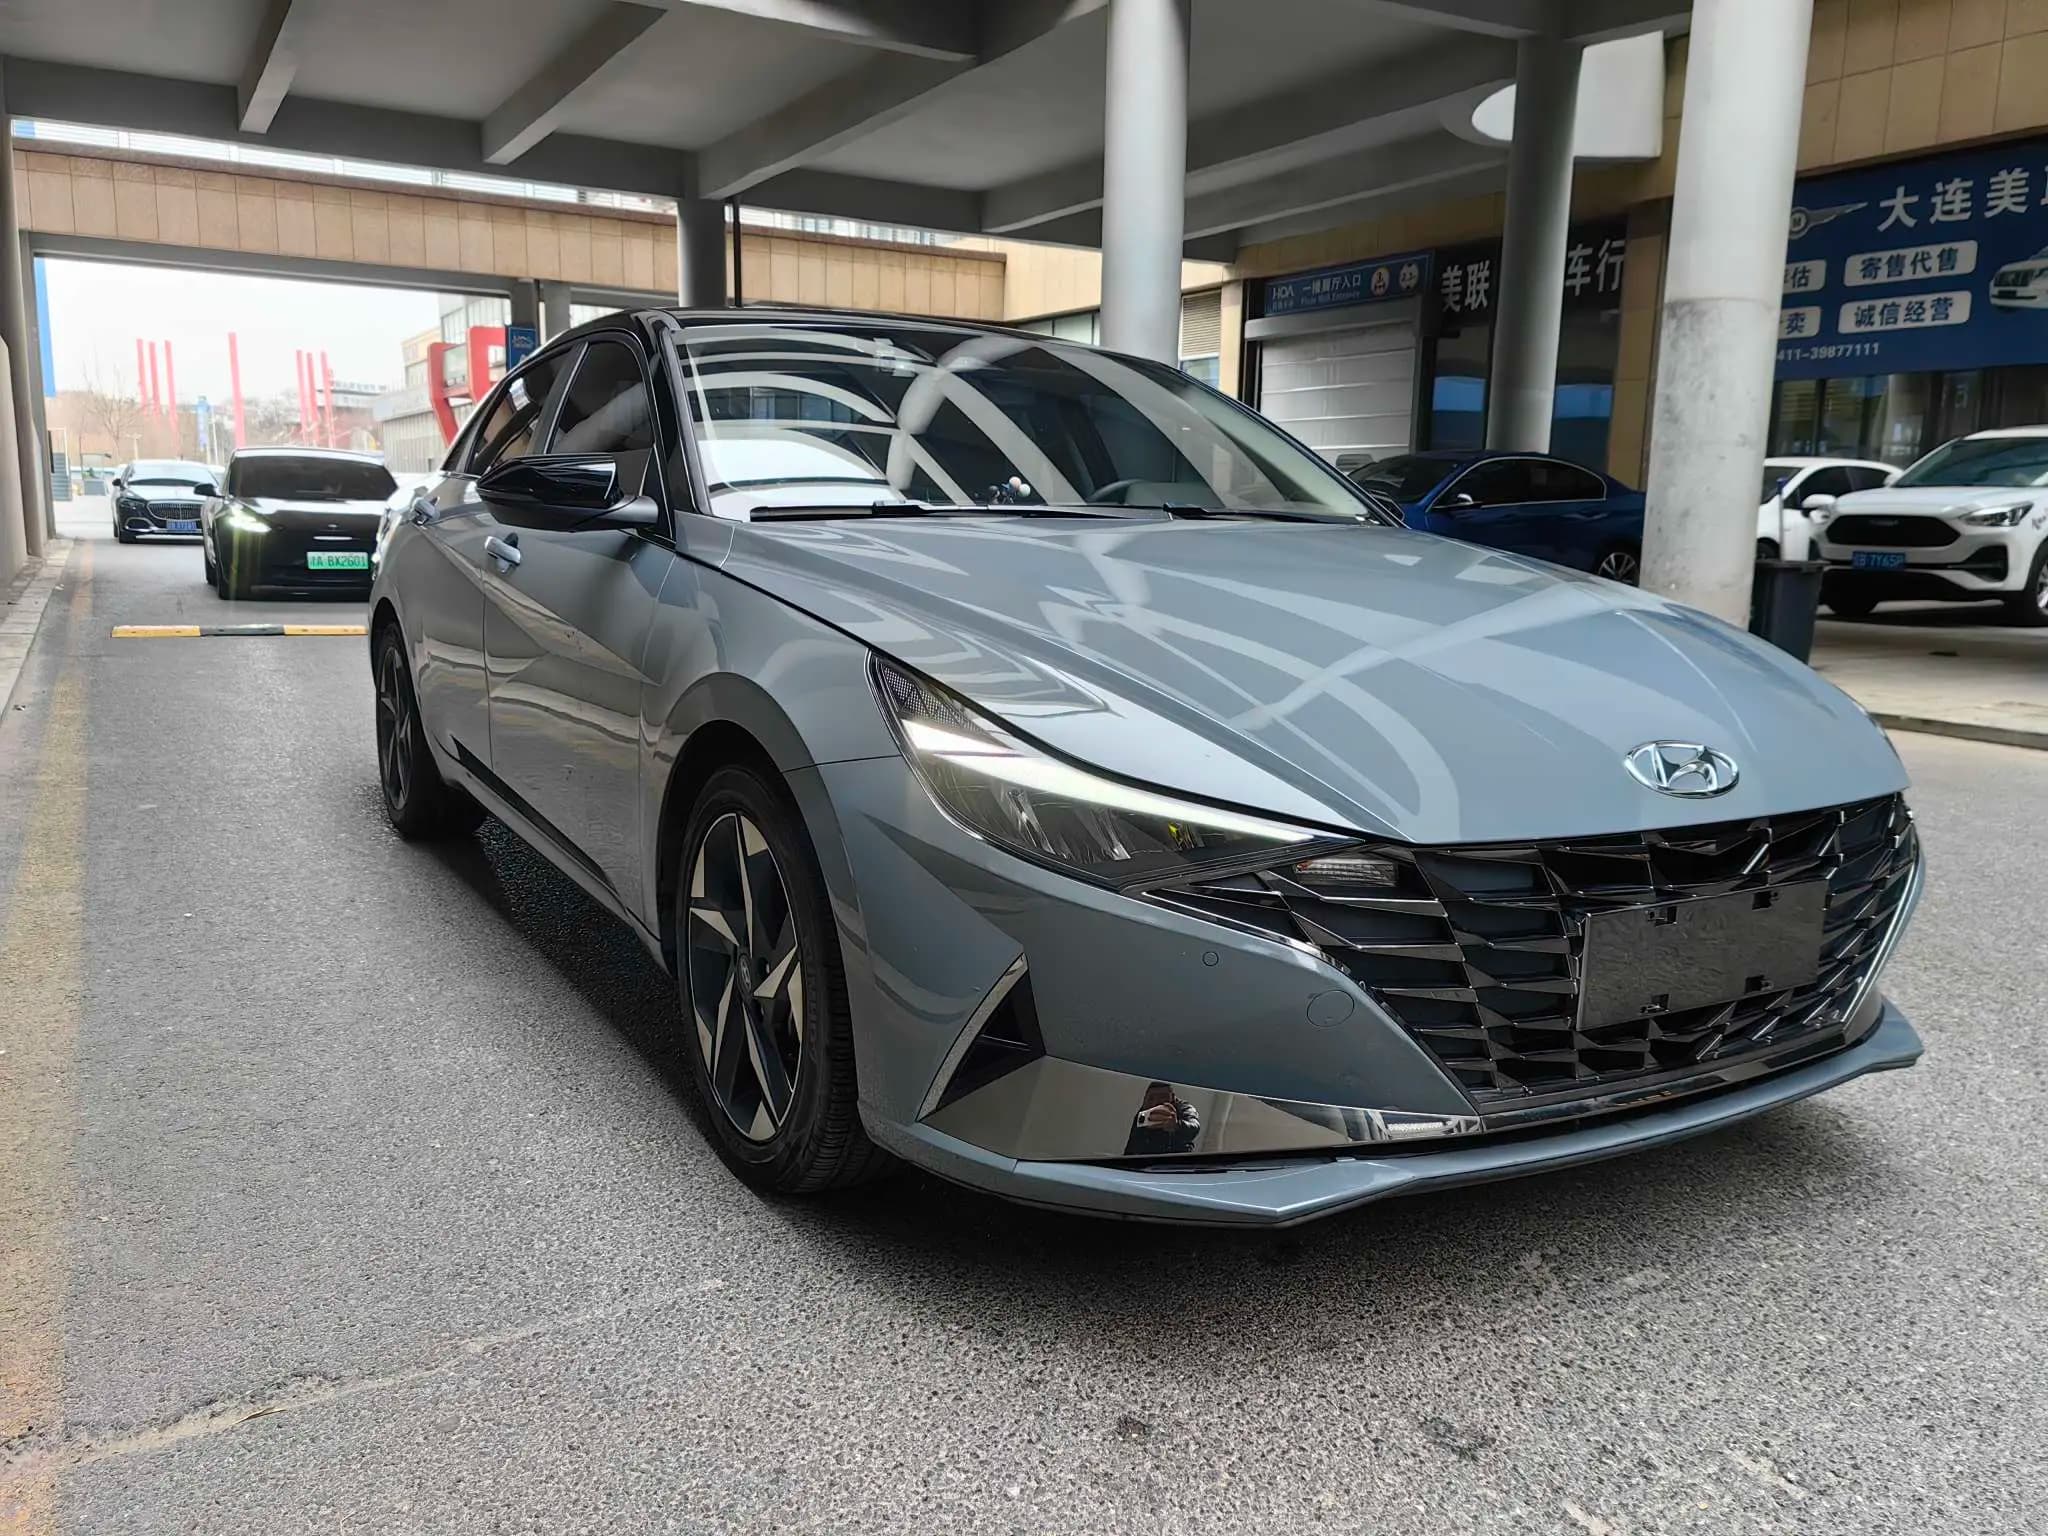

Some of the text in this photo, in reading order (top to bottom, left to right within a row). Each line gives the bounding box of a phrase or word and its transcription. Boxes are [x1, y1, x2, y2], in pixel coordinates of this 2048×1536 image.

[1877, 165, 2048, 232] 大连美
[1440, 239, 1625, 312] 美联 车行
[1860, 247, 1958, 280] 寄售代售
[1779, 311, 1806, 334] 卖
[1854, 297, 1953, 328] 诚信经营
